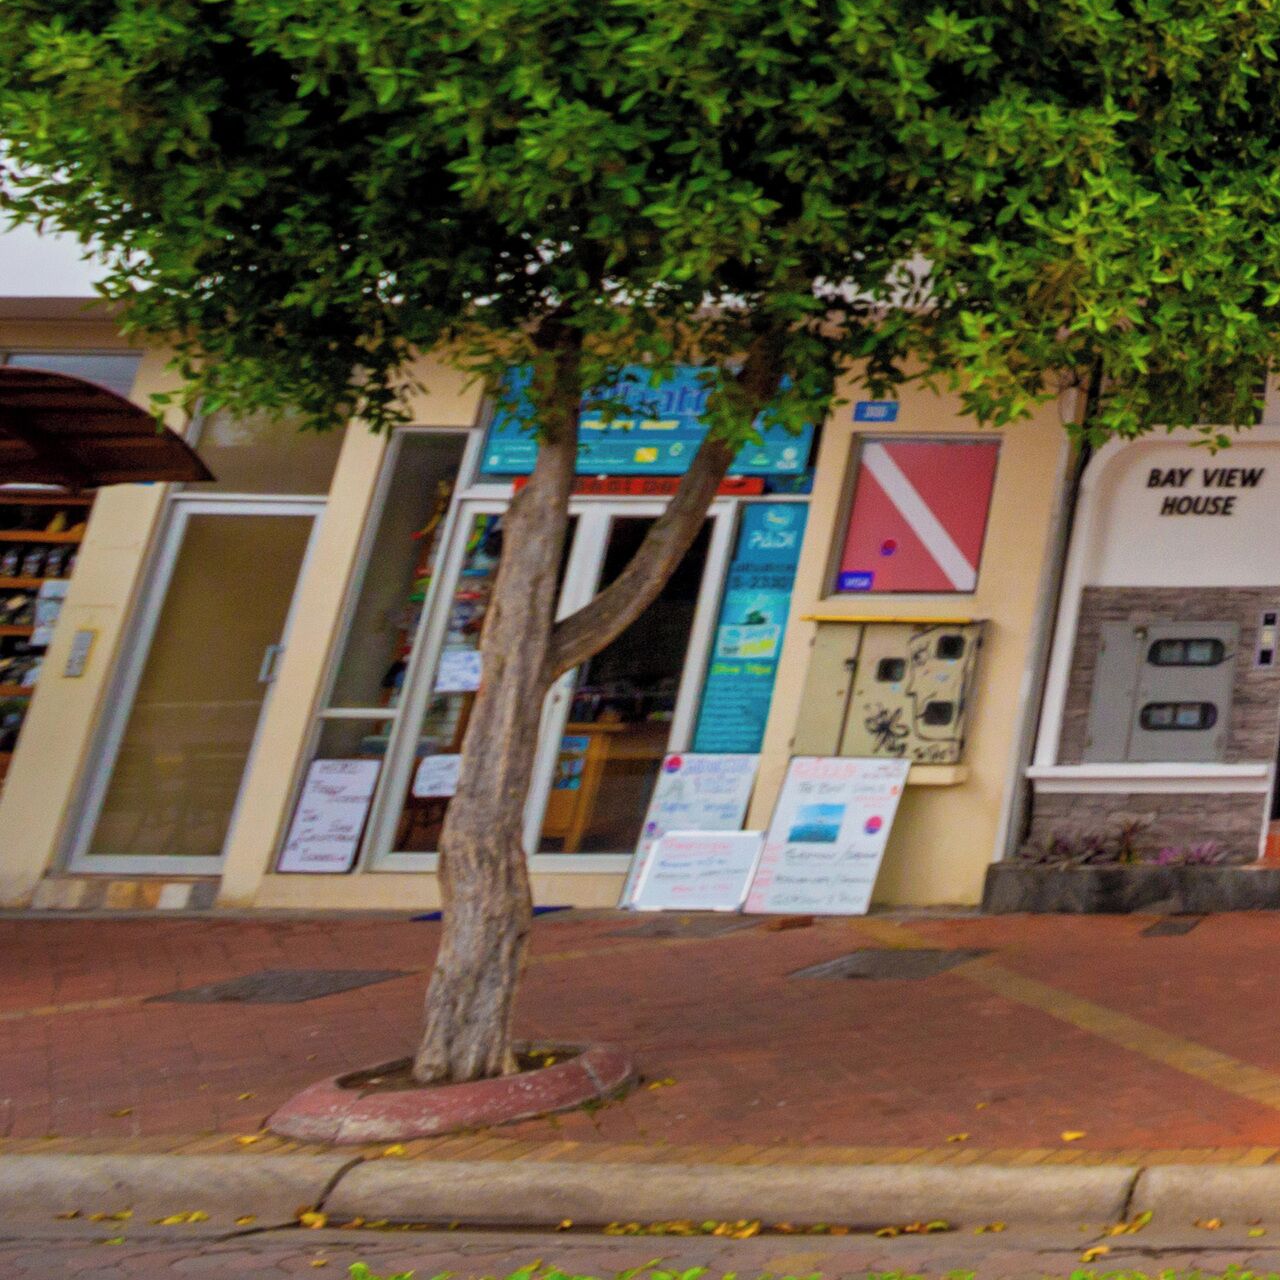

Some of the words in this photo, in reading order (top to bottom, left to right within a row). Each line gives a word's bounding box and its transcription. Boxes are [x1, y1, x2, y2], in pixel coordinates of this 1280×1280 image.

[1147, 468, 1194, 488] BAY
[1203, 468, 1266, 488] VIEW
[1160, 496, 1237, 516] HOUSE
